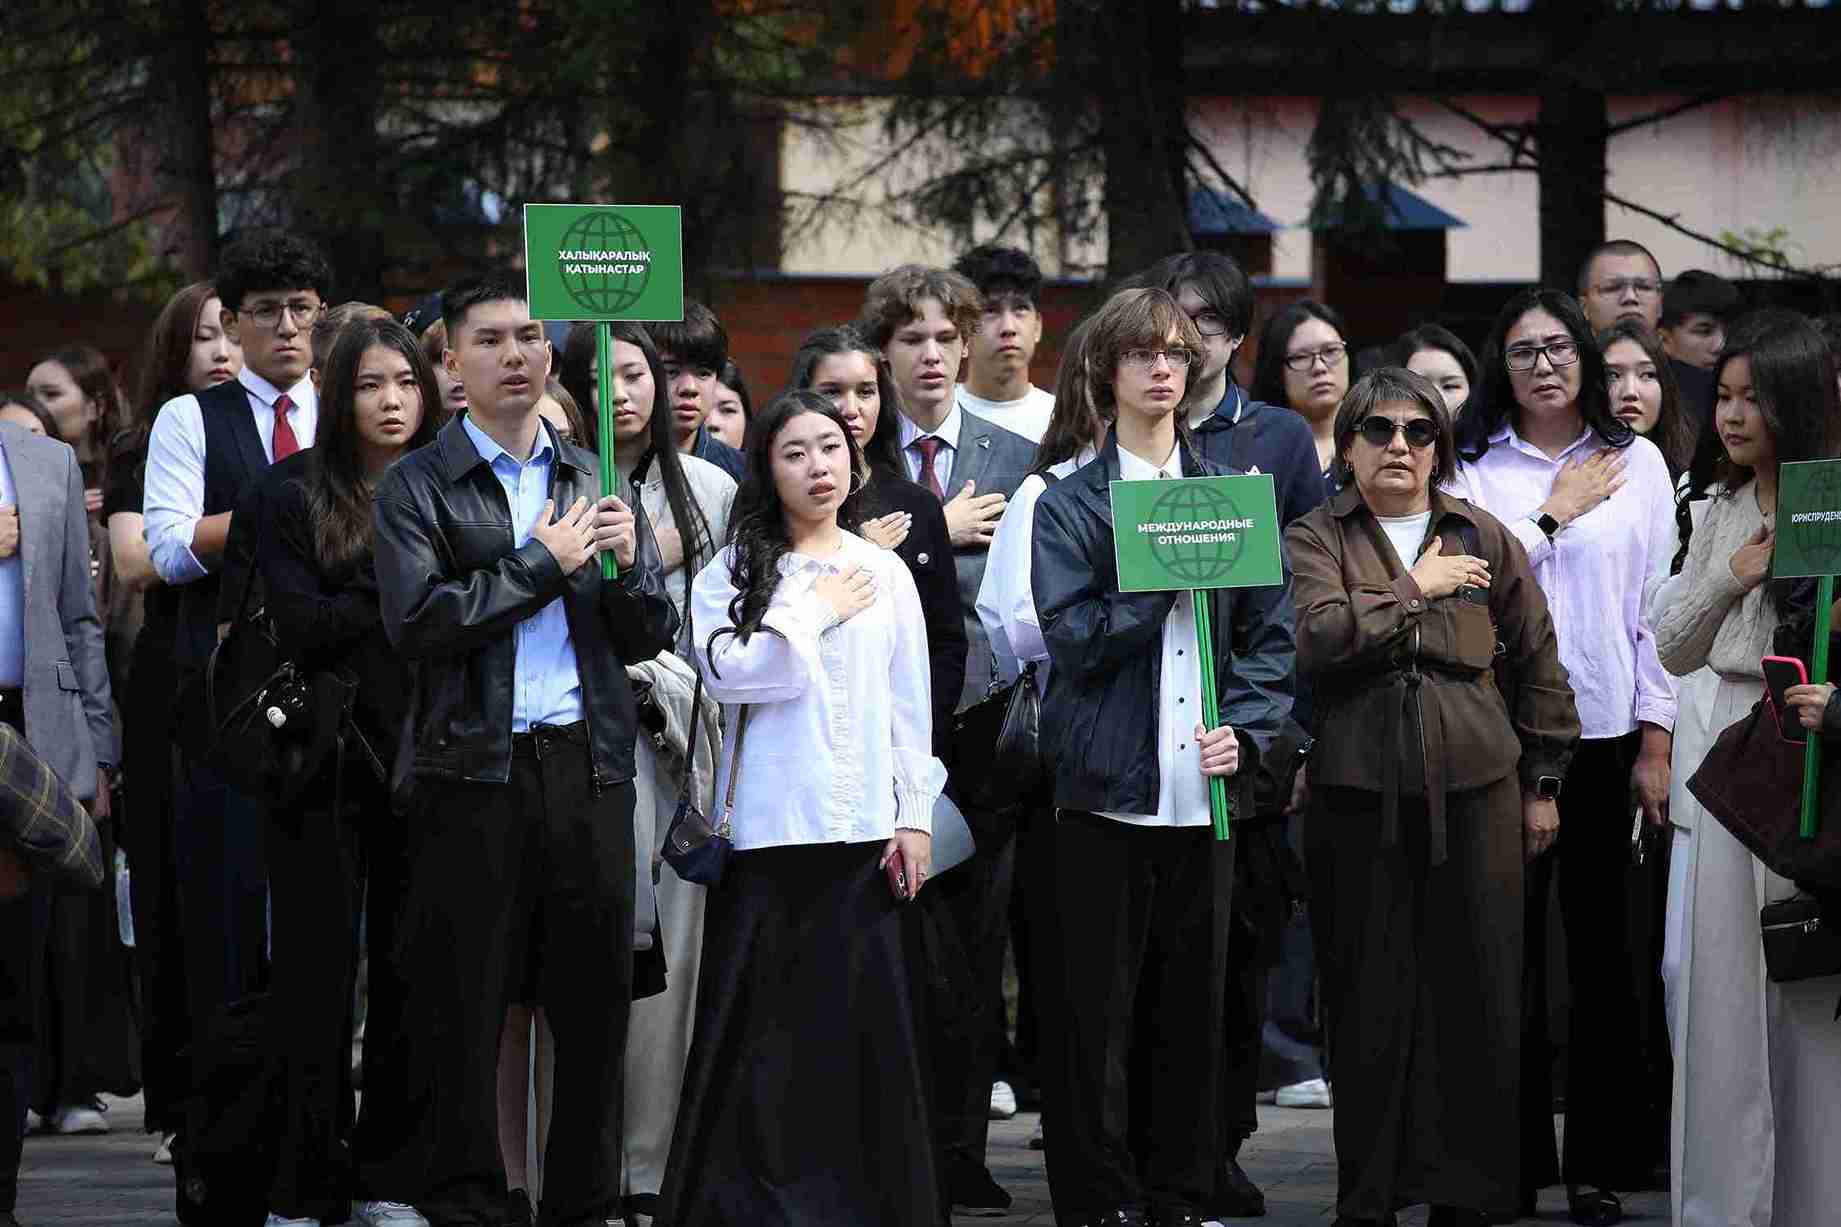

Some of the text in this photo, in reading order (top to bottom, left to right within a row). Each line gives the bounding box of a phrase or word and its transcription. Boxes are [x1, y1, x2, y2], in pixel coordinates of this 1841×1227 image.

[558, 250, 651, 263] ХАЛЫҚАРАЛЫҚ
[565, 264, 645, 275] ҚАТЫНАСТАР
[1137, 518, 1254, 533] МЕЖДУНАРОДНЫЕ
[1158, 532, 1236, 545] ОТНОШЕНИЯ
